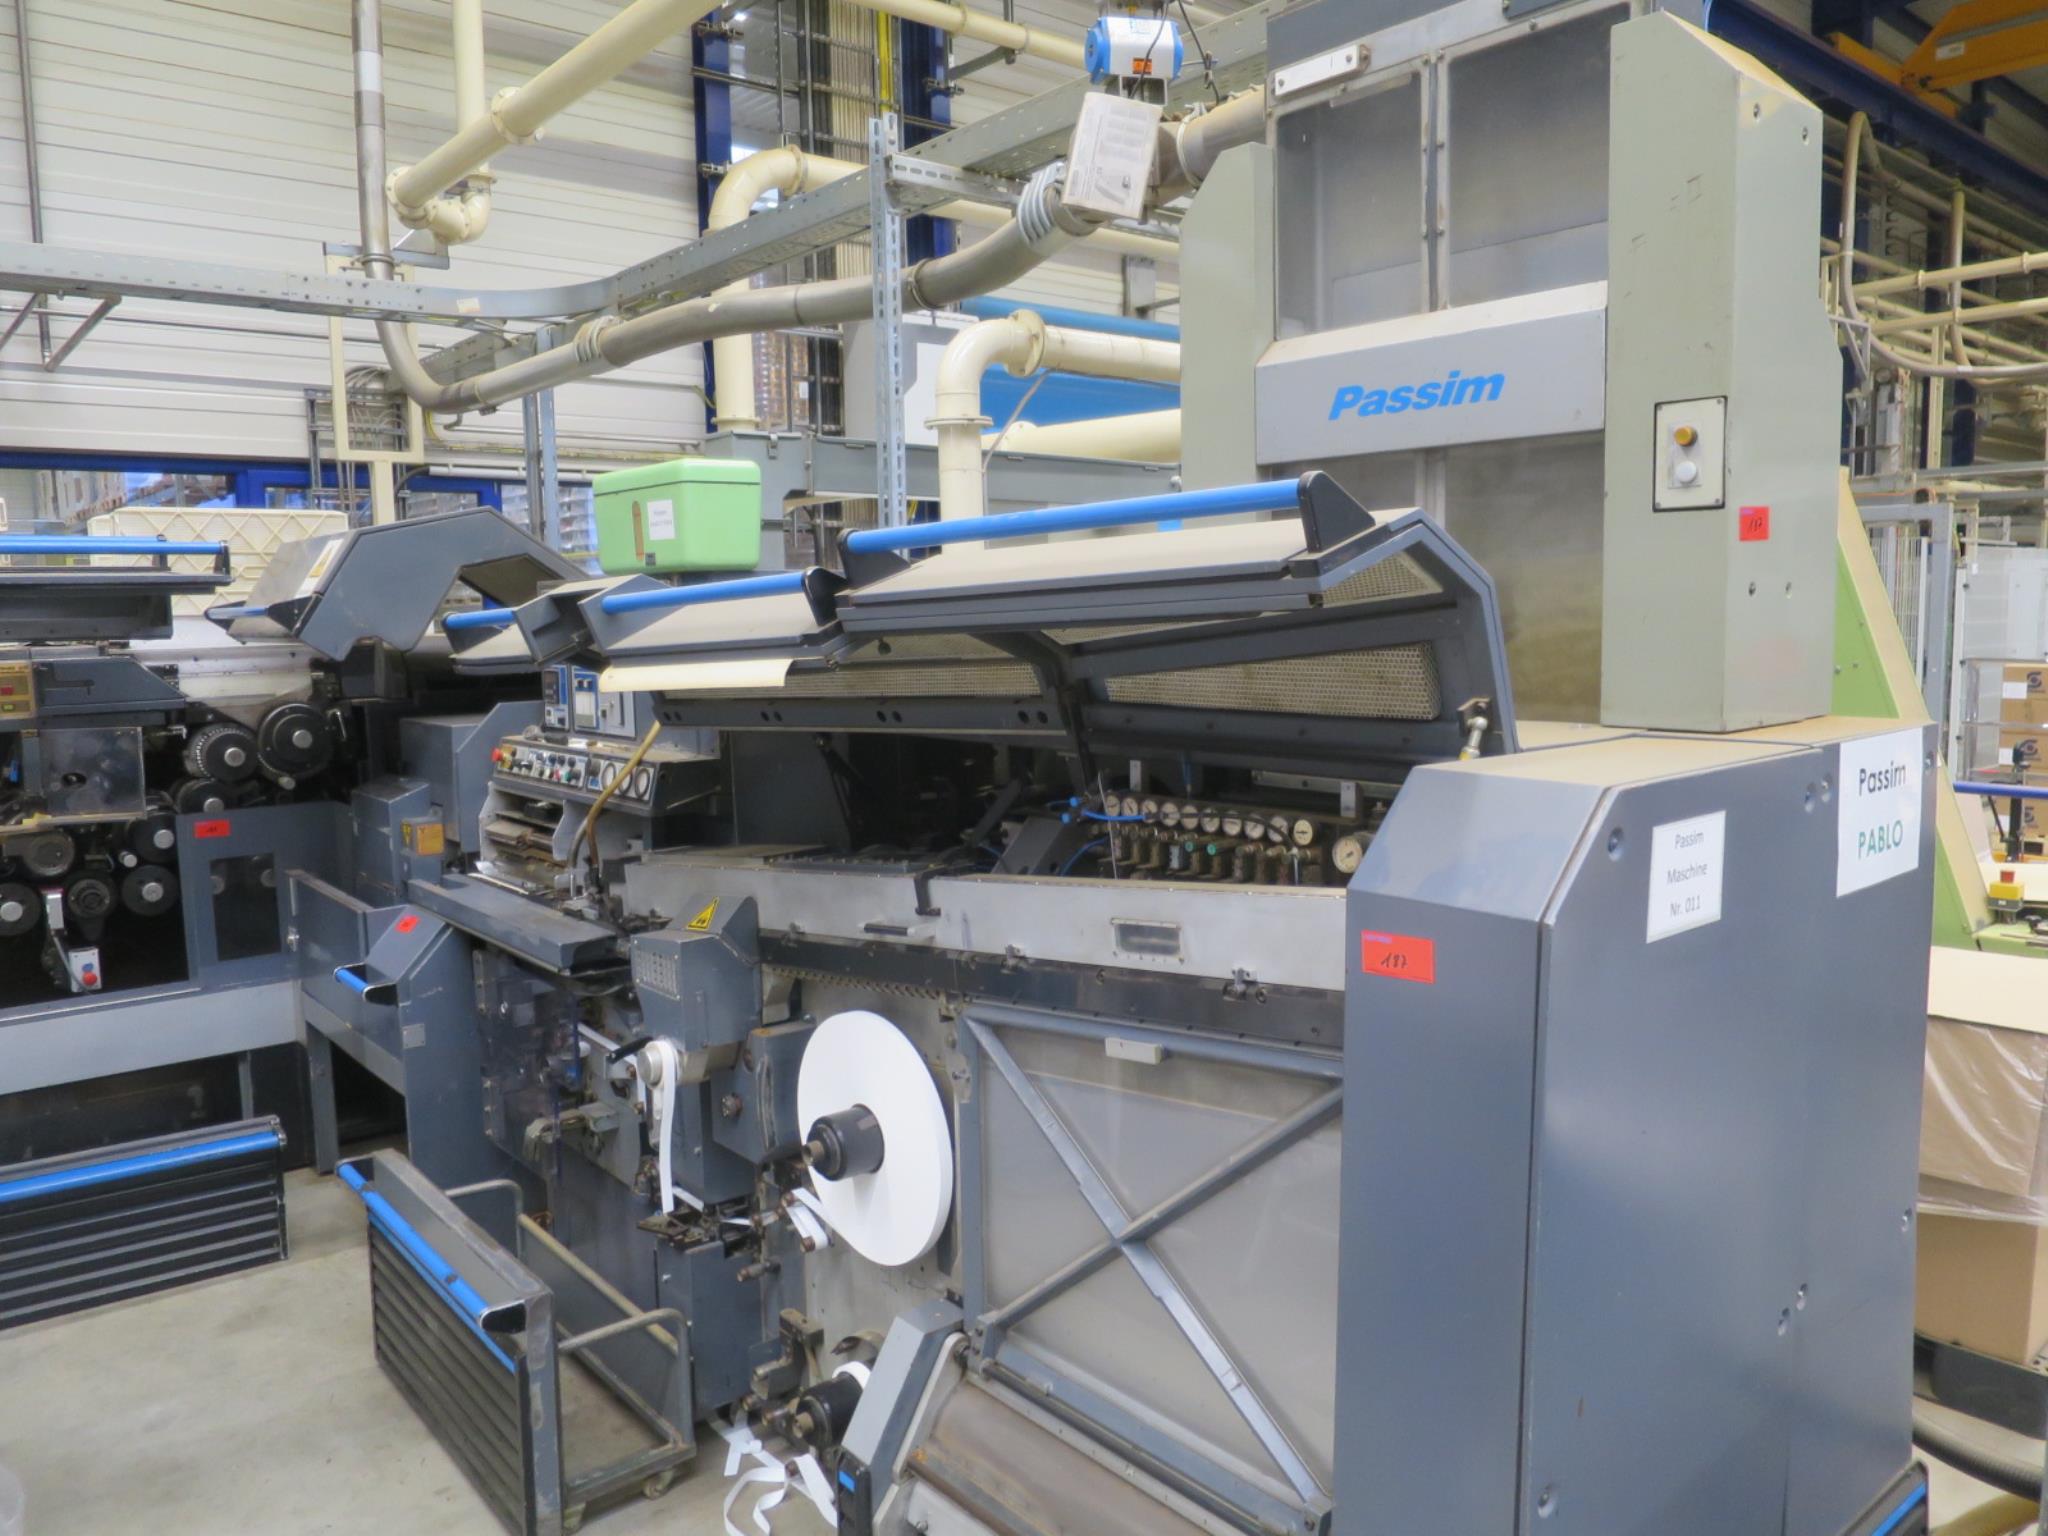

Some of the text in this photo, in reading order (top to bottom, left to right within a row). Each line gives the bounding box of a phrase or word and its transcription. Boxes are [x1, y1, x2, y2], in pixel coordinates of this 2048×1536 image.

[1328, 370, 1505, 421] Passim
[1858, 760, 1906, 797] Passim
[1674, 831, 1704, 850] Passim
[1857, 820, 1904, 860] PABLO
[1666, 862, 1708, 884] Maschine
[1669, 895, 1701, 918] Nr. 011
